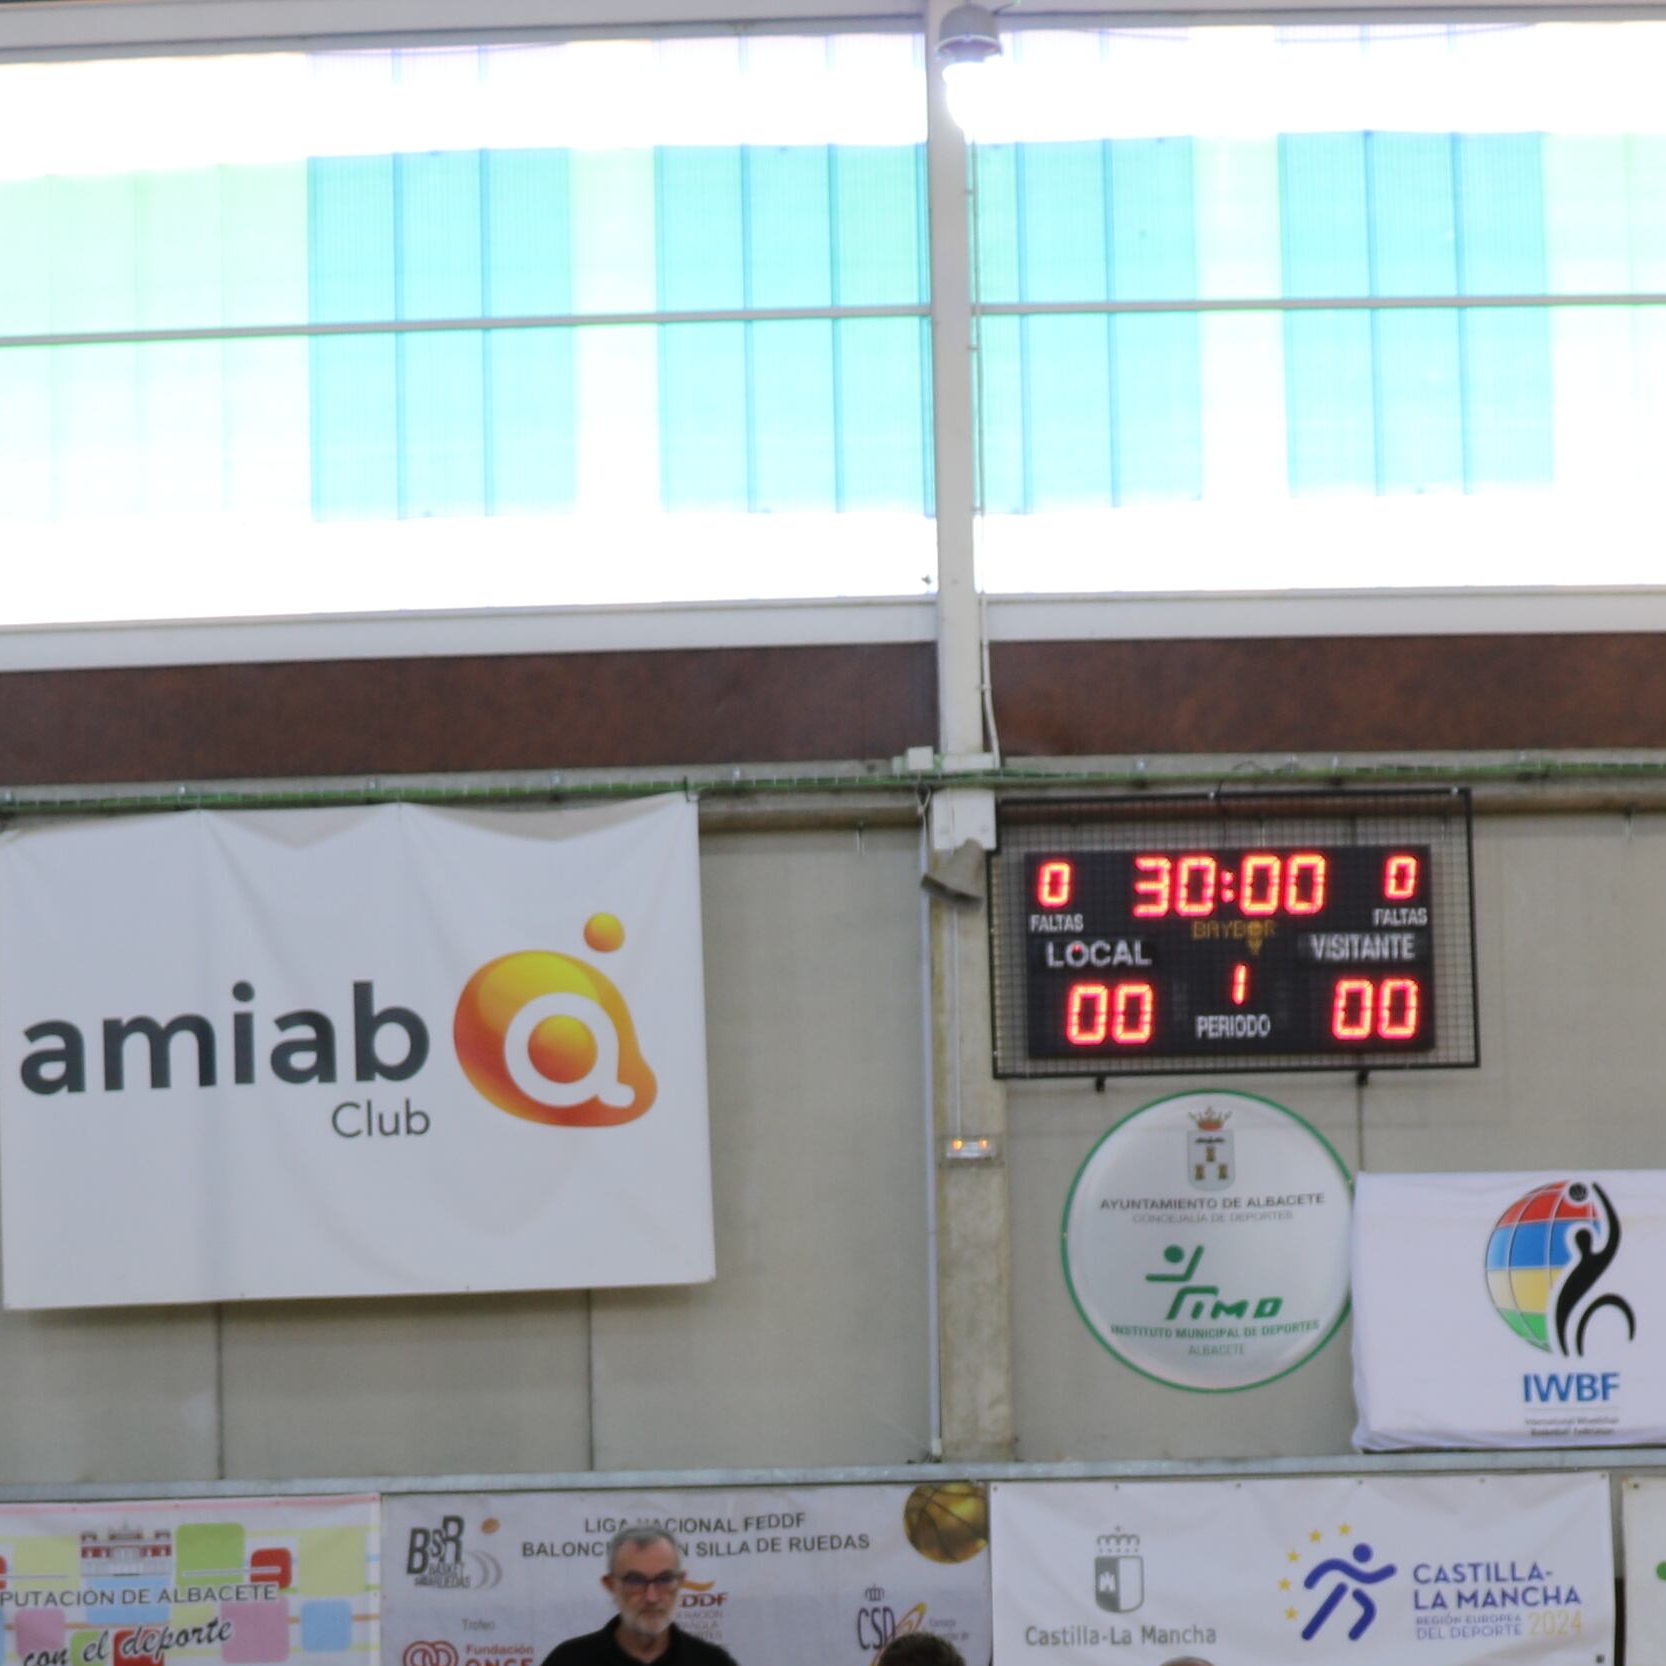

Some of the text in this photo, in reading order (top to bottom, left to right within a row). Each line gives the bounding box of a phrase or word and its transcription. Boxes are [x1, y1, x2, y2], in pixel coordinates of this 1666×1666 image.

[1038, 859, 1072, 908] 0
[1133, 855, 1327, 918] 30:00
[1383, 855, 1418, 901] 0
[1030, 913, 1085, 933] FALTAS
[1373, 907, 1429, 928] FALTAS
[1047, 941, 1153, 968] LOCAL
[1310, 932, 1416, 961] VISITANTE
[1066, 983, 1154, 1046] 00
[1332, 978, 1419, 1041] 00
[19, 980, 431, 1096] amiab
[1196, 1013, 1272, 1039] PERIODO
[331, 1099, 431, 1139] Club
[1100, 1192, 1326, 1211] AYUNTAMIENTO DE ALBACETE
[1175, 1326, 1241, 1340] MUNICIPAL
[1244, 1326, 1259, 1338] DE
[1261, 1319, 1321, 1336] DEPORTES
[1523, 1371, 1620, 1402] IWBF
[637, 1517, 737, 1534] ACIONAL
[744, 1512, 806, 1531] FEDDF
[696, 1538, 751, 1557] SILLA
[756, 1536, 782, 1553] DE
[789, 1533, 871, 1551] RUEDAS
[1413, 1561, 1554, 1585] CASTILLA-
[121, 1587, 151, 1606] DE
[157, 1583, 278, 1604] ALBACETE
[1413, 1585, 1582, 1611] LA MANCHA
[1025, 1624, 1217, 1647] Castilla-La Mancha
[1416, 1624, 1523, 1641] DEL DEPORTE
[1528, 1610, 1582, 1636] 2024
[82, 1629, 109, 1663] el
[120, 1617, 233, 1662] deporte
[466, 1643, 534, 1655] Fundación
